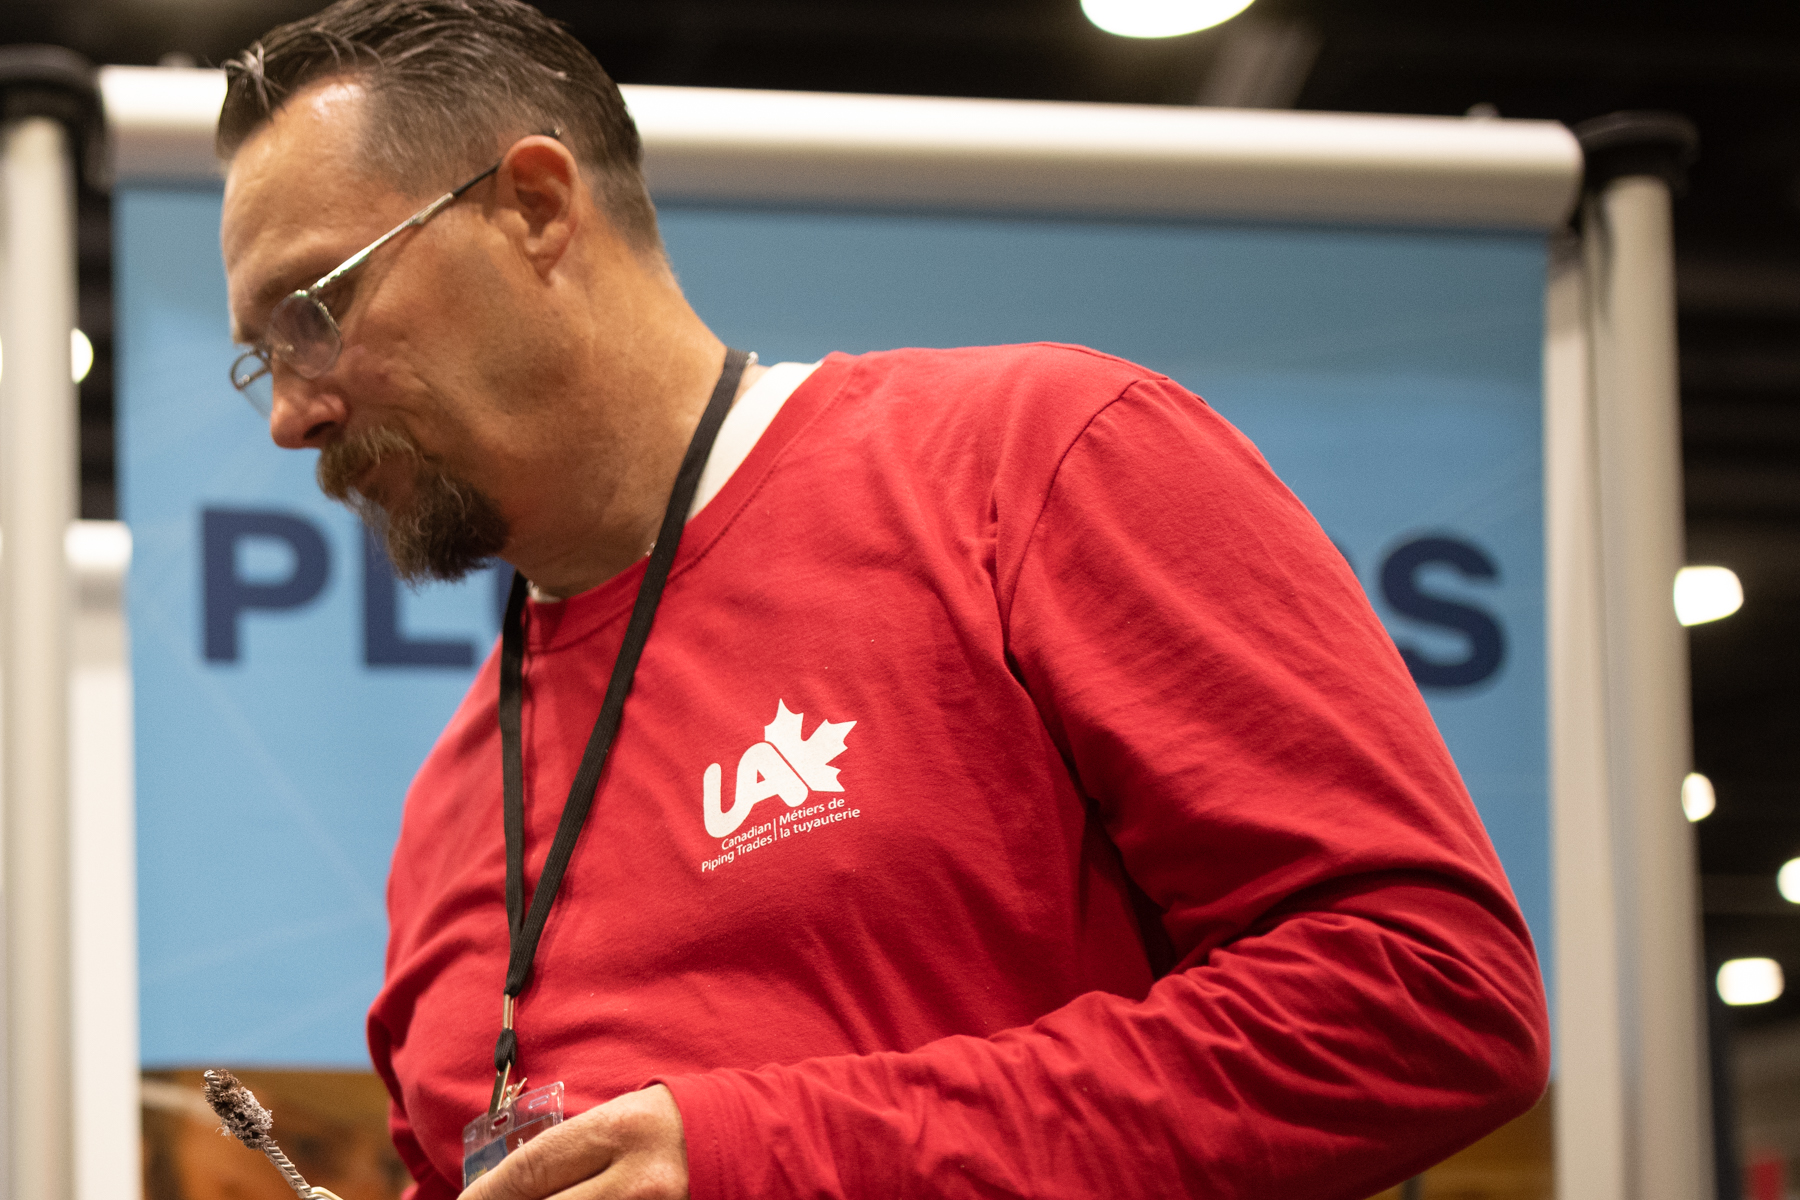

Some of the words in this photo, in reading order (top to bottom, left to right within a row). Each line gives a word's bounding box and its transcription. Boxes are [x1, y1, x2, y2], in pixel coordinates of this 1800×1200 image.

[779, 803, 825, 826] Métiers
[828, 798, 845, 810] de
[780, 827, 791, 839] la
[793, 808, 861, 834] tuyauterie
[721, 821, 772, 850] Canadian
[701, 851, 735, 873] Piping
[736, 834, 773, 856] Trades
